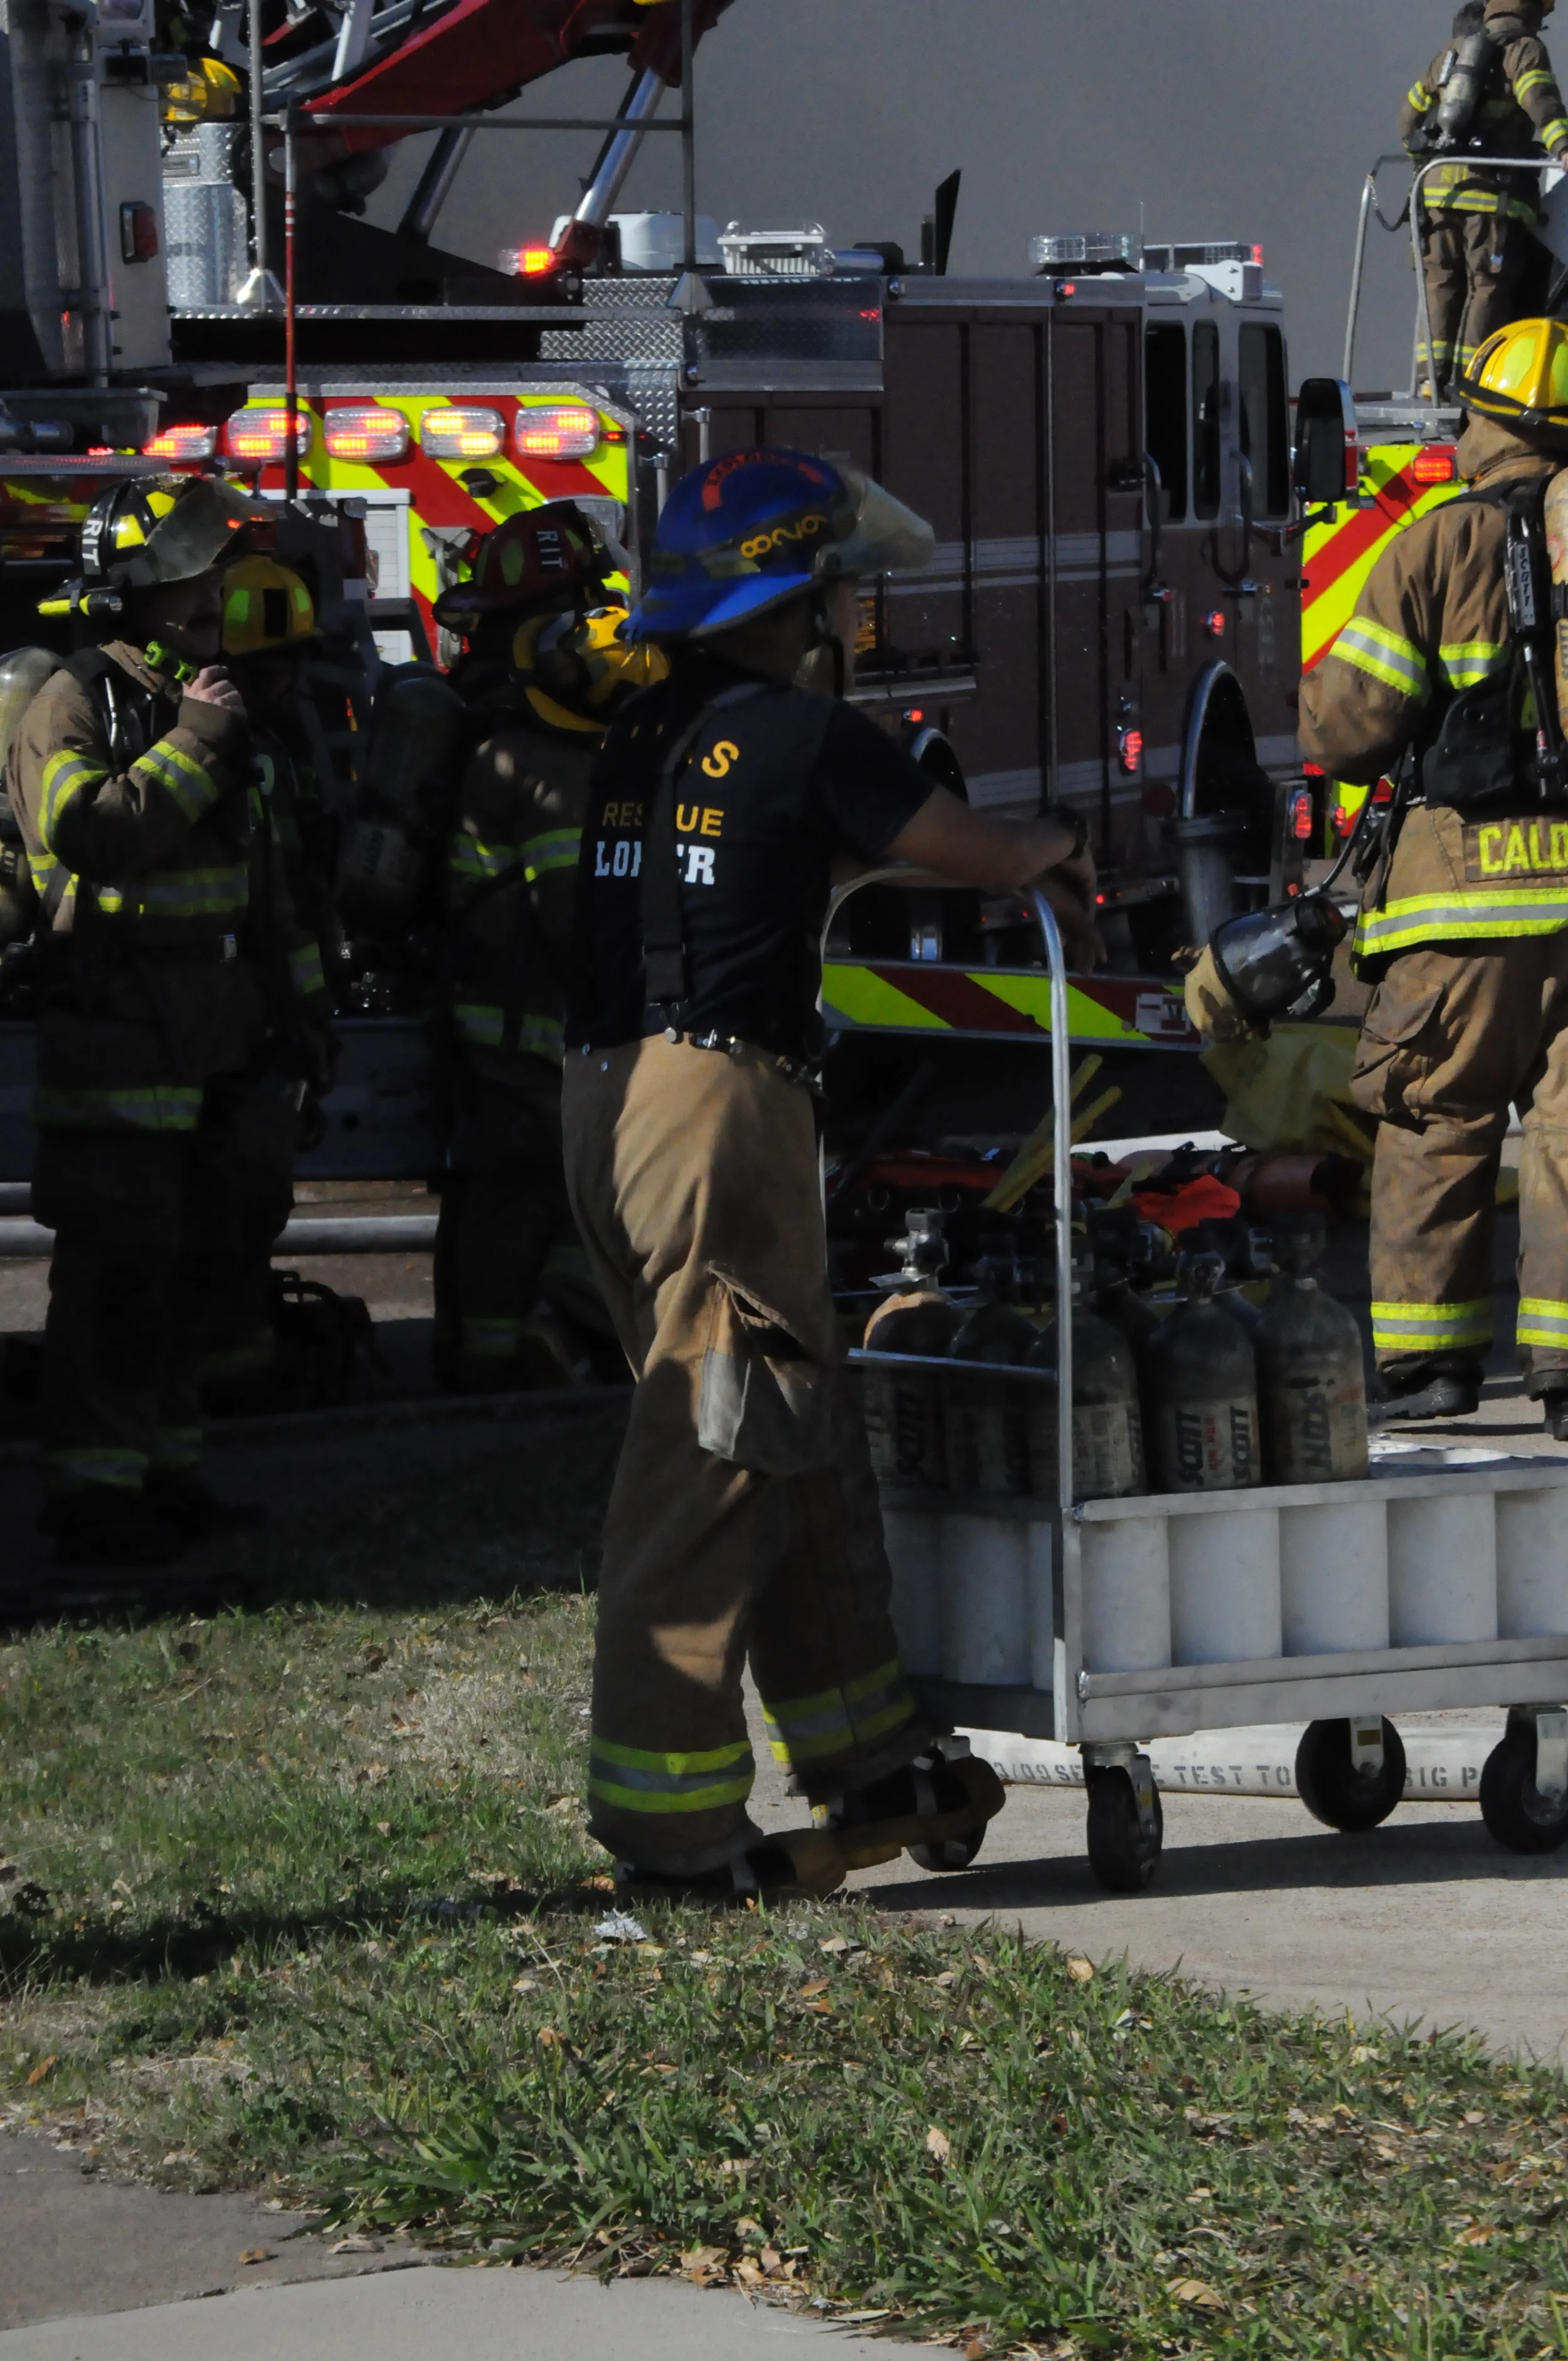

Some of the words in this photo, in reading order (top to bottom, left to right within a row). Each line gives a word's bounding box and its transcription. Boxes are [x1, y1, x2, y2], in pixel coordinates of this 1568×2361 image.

[82, 519, 104, 566] RIT
[536, 531, 563, 568] RIT
[601, 801, 724, 837] RESUE
[1175, 1409, 1204, 1486] SCOTT
[1173, 1765, 1242, 1785] TEST
[1256, 1765, 1291, 1786] TO
